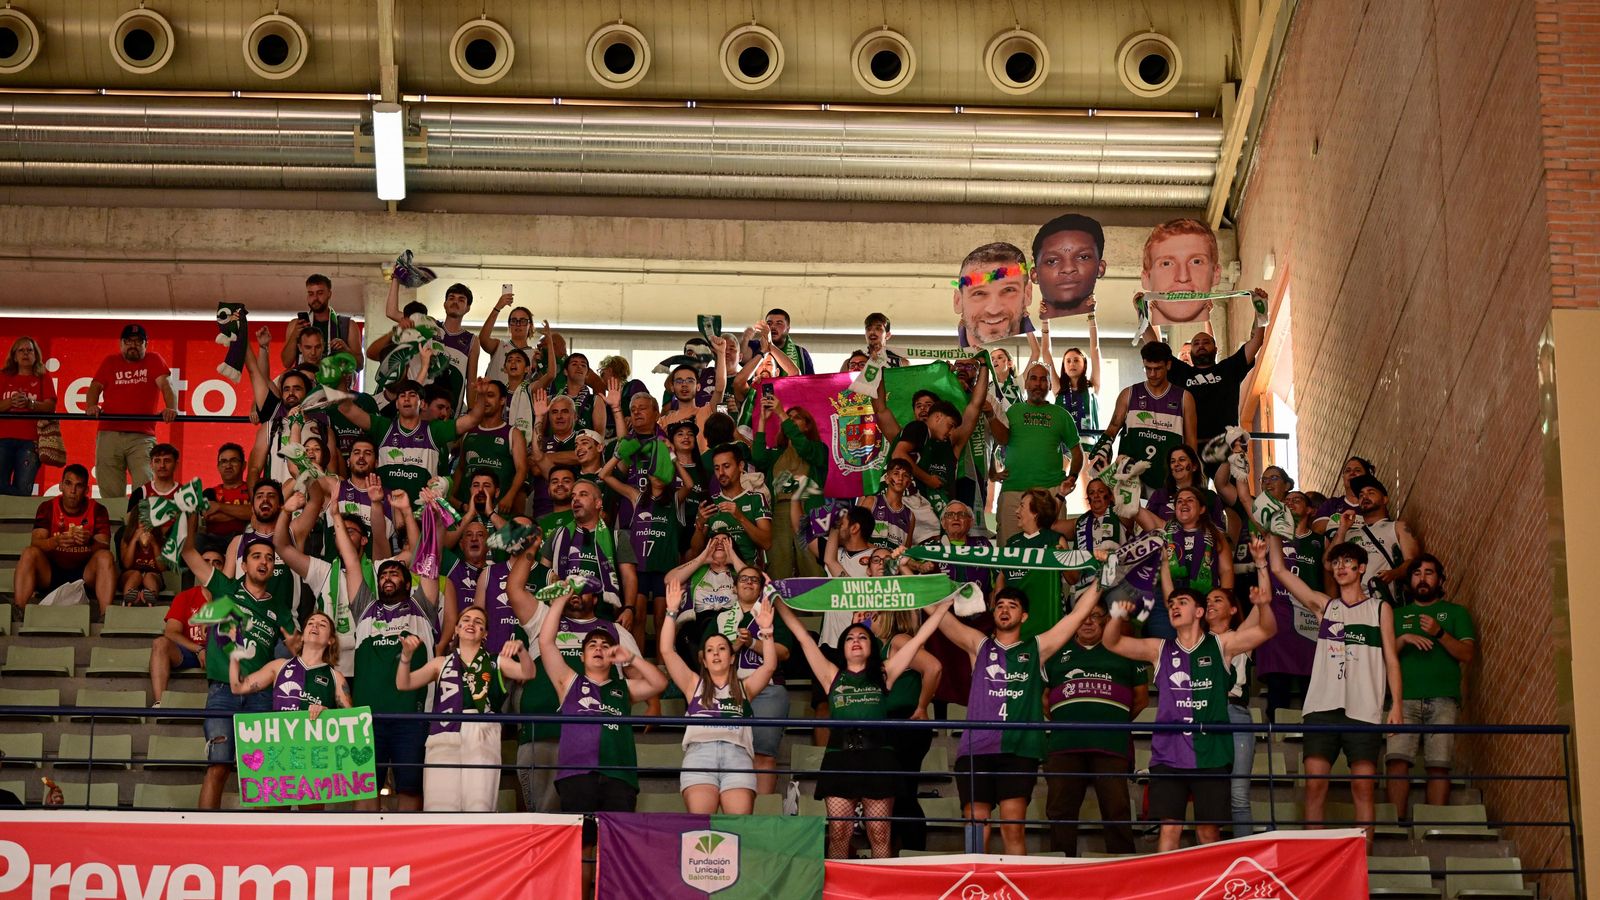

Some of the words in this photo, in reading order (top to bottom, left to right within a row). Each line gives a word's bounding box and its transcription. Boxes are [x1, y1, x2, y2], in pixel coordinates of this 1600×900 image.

[115, 368, 148, 380] UCAM
[1152, 420, 1172, 428] Unicaja
[1138, 430, 1167, 442] málaga
[1145, 445, 1157, 460] 9
[402, 456, 423, 464] Unicaja
[477, 458, 502, 466] Unicaja
[388, 468, 418, 480] málaga
[636, 528, 666, 538] málaga
[642, 540, 655, 557] 17
[578, 552, 598, 560] Unica
[842, 580, 901, 594] UNICAJA
[830, 593, 915, 608] BALONCESTO
[373, 636, 400, 646] mála
[1083, 672, 1112, 680] Unicaja
[1189, 678, 1212, 688] Unicaja
[988, 688, 1024, 700] málaga
[998, 702, 1008, 721] 4
[238, 718, 300, 744] WHY
[304, 712, 372, 744] NOT?
[268, 744, 350, 771] KEEP
[240, 771, 375, 804] DREAMING
[688, 857, 730, 866] Fundación
[695, 866, 725, 875] Unicaja
